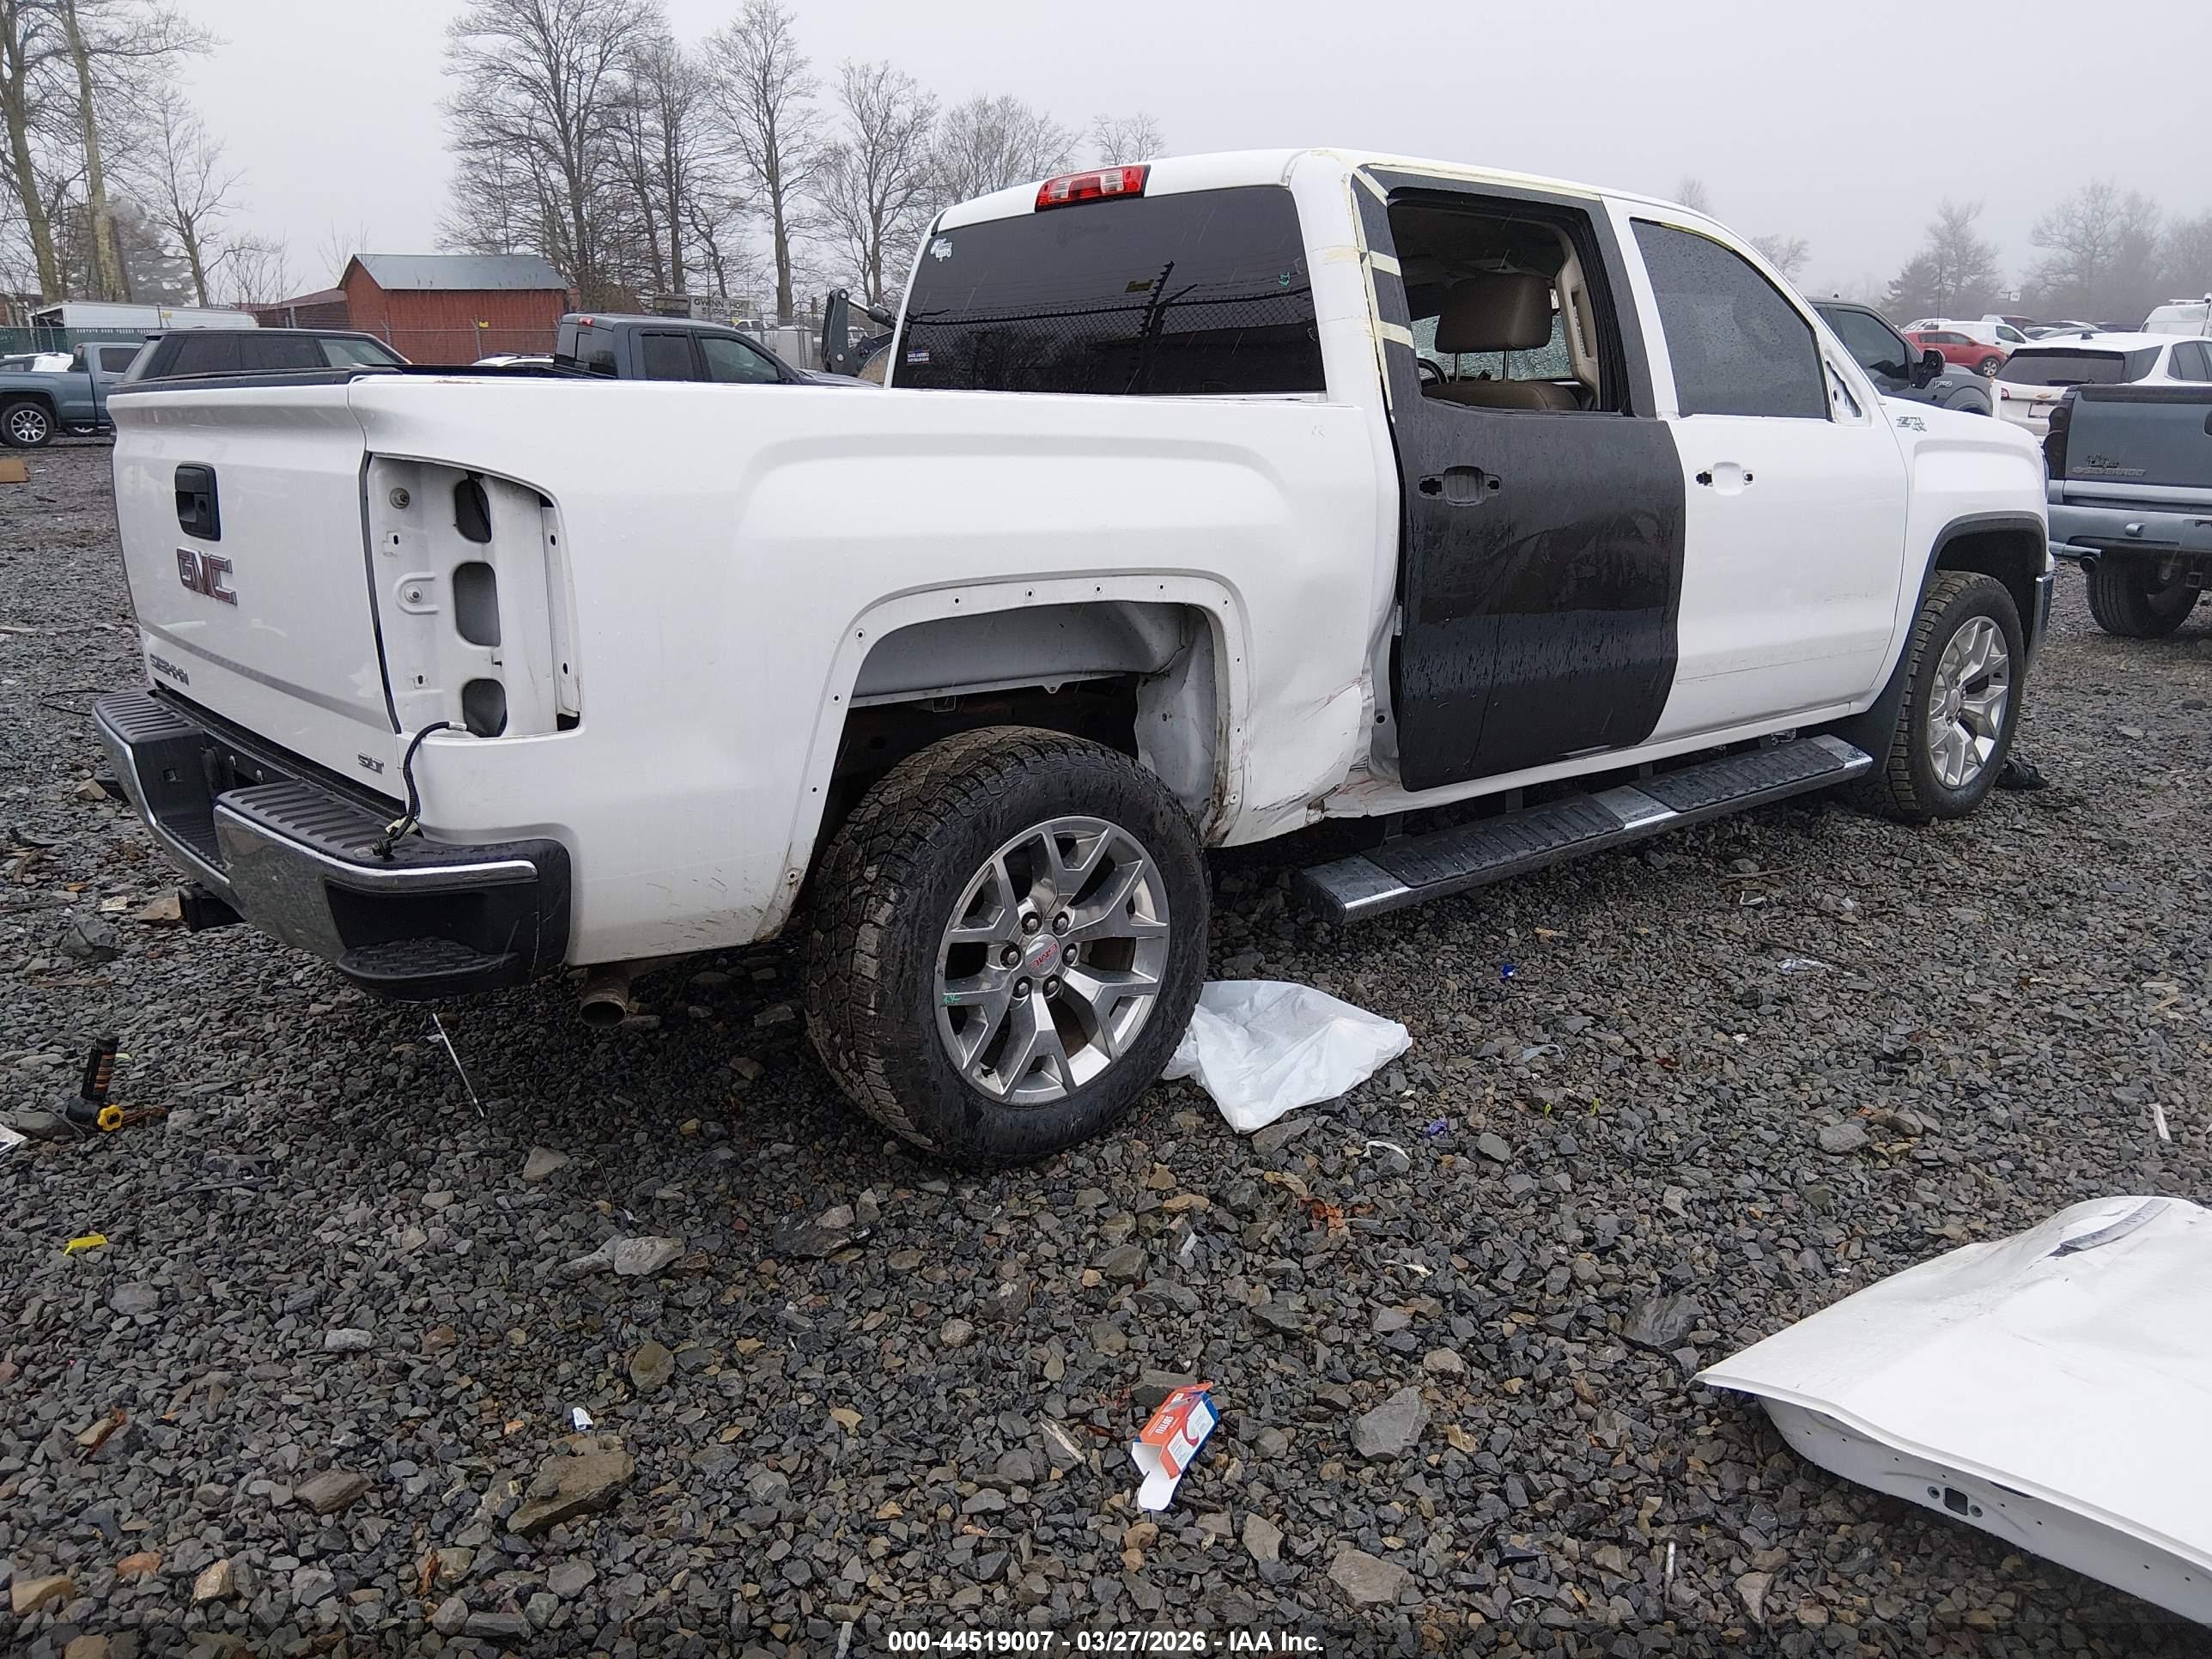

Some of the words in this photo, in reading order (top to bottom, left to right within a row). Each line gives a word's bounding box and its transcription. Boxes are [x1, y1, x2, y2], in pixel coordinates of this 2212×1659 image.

[694, 298, 724, 308] GWINN
[176, 546, 238, 606] GMC
[357, 751, 386, 775] SLT
[1030, 941, 1059, 970] GMC
